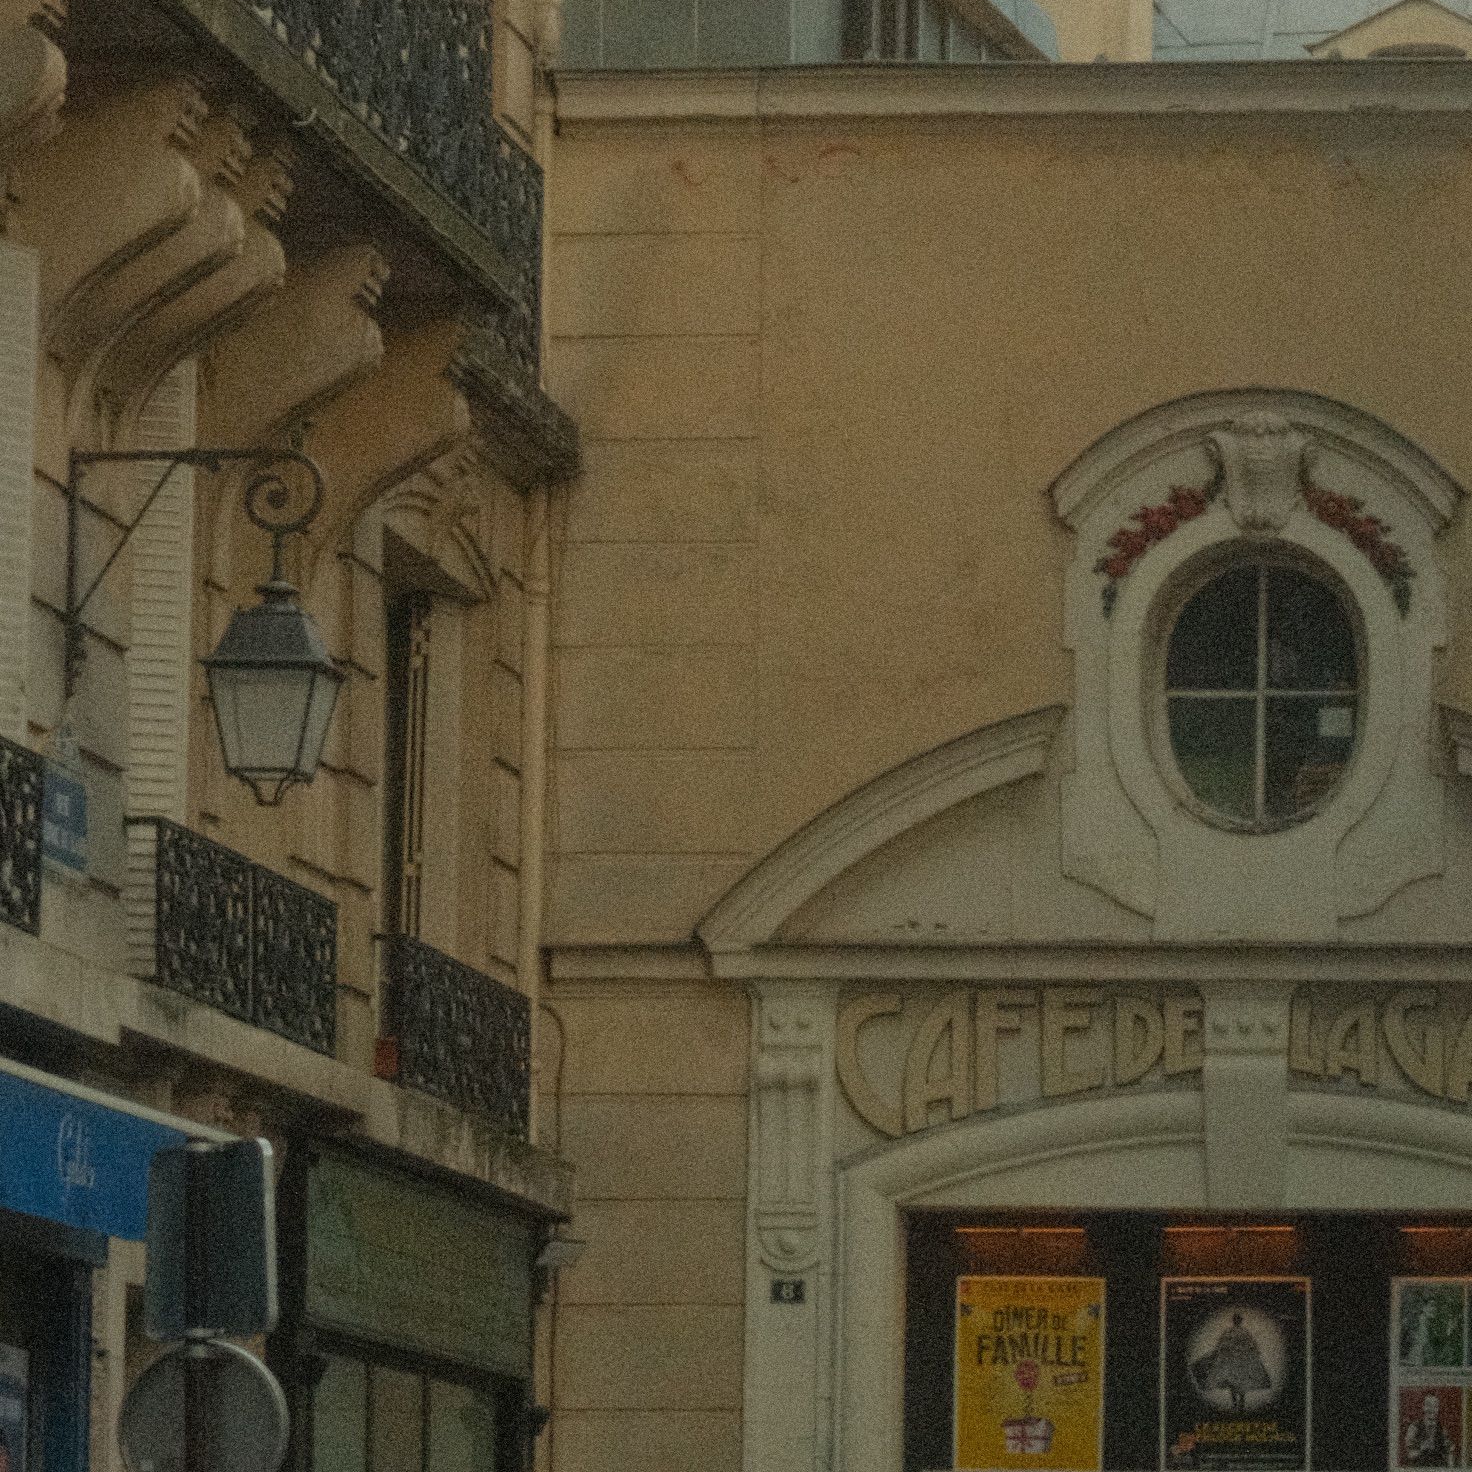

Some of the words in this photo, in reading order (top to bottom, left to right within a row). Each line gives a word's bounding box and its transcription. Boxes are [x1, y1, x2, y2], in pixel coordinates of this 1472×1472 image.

[835, 988, 1105, 1139] CAFE
[1113, 994, 1204, 1088] DE
[1288, 996, 1377, 1085] LA
[976, 1333, 1088, 1367] FAMILLE
